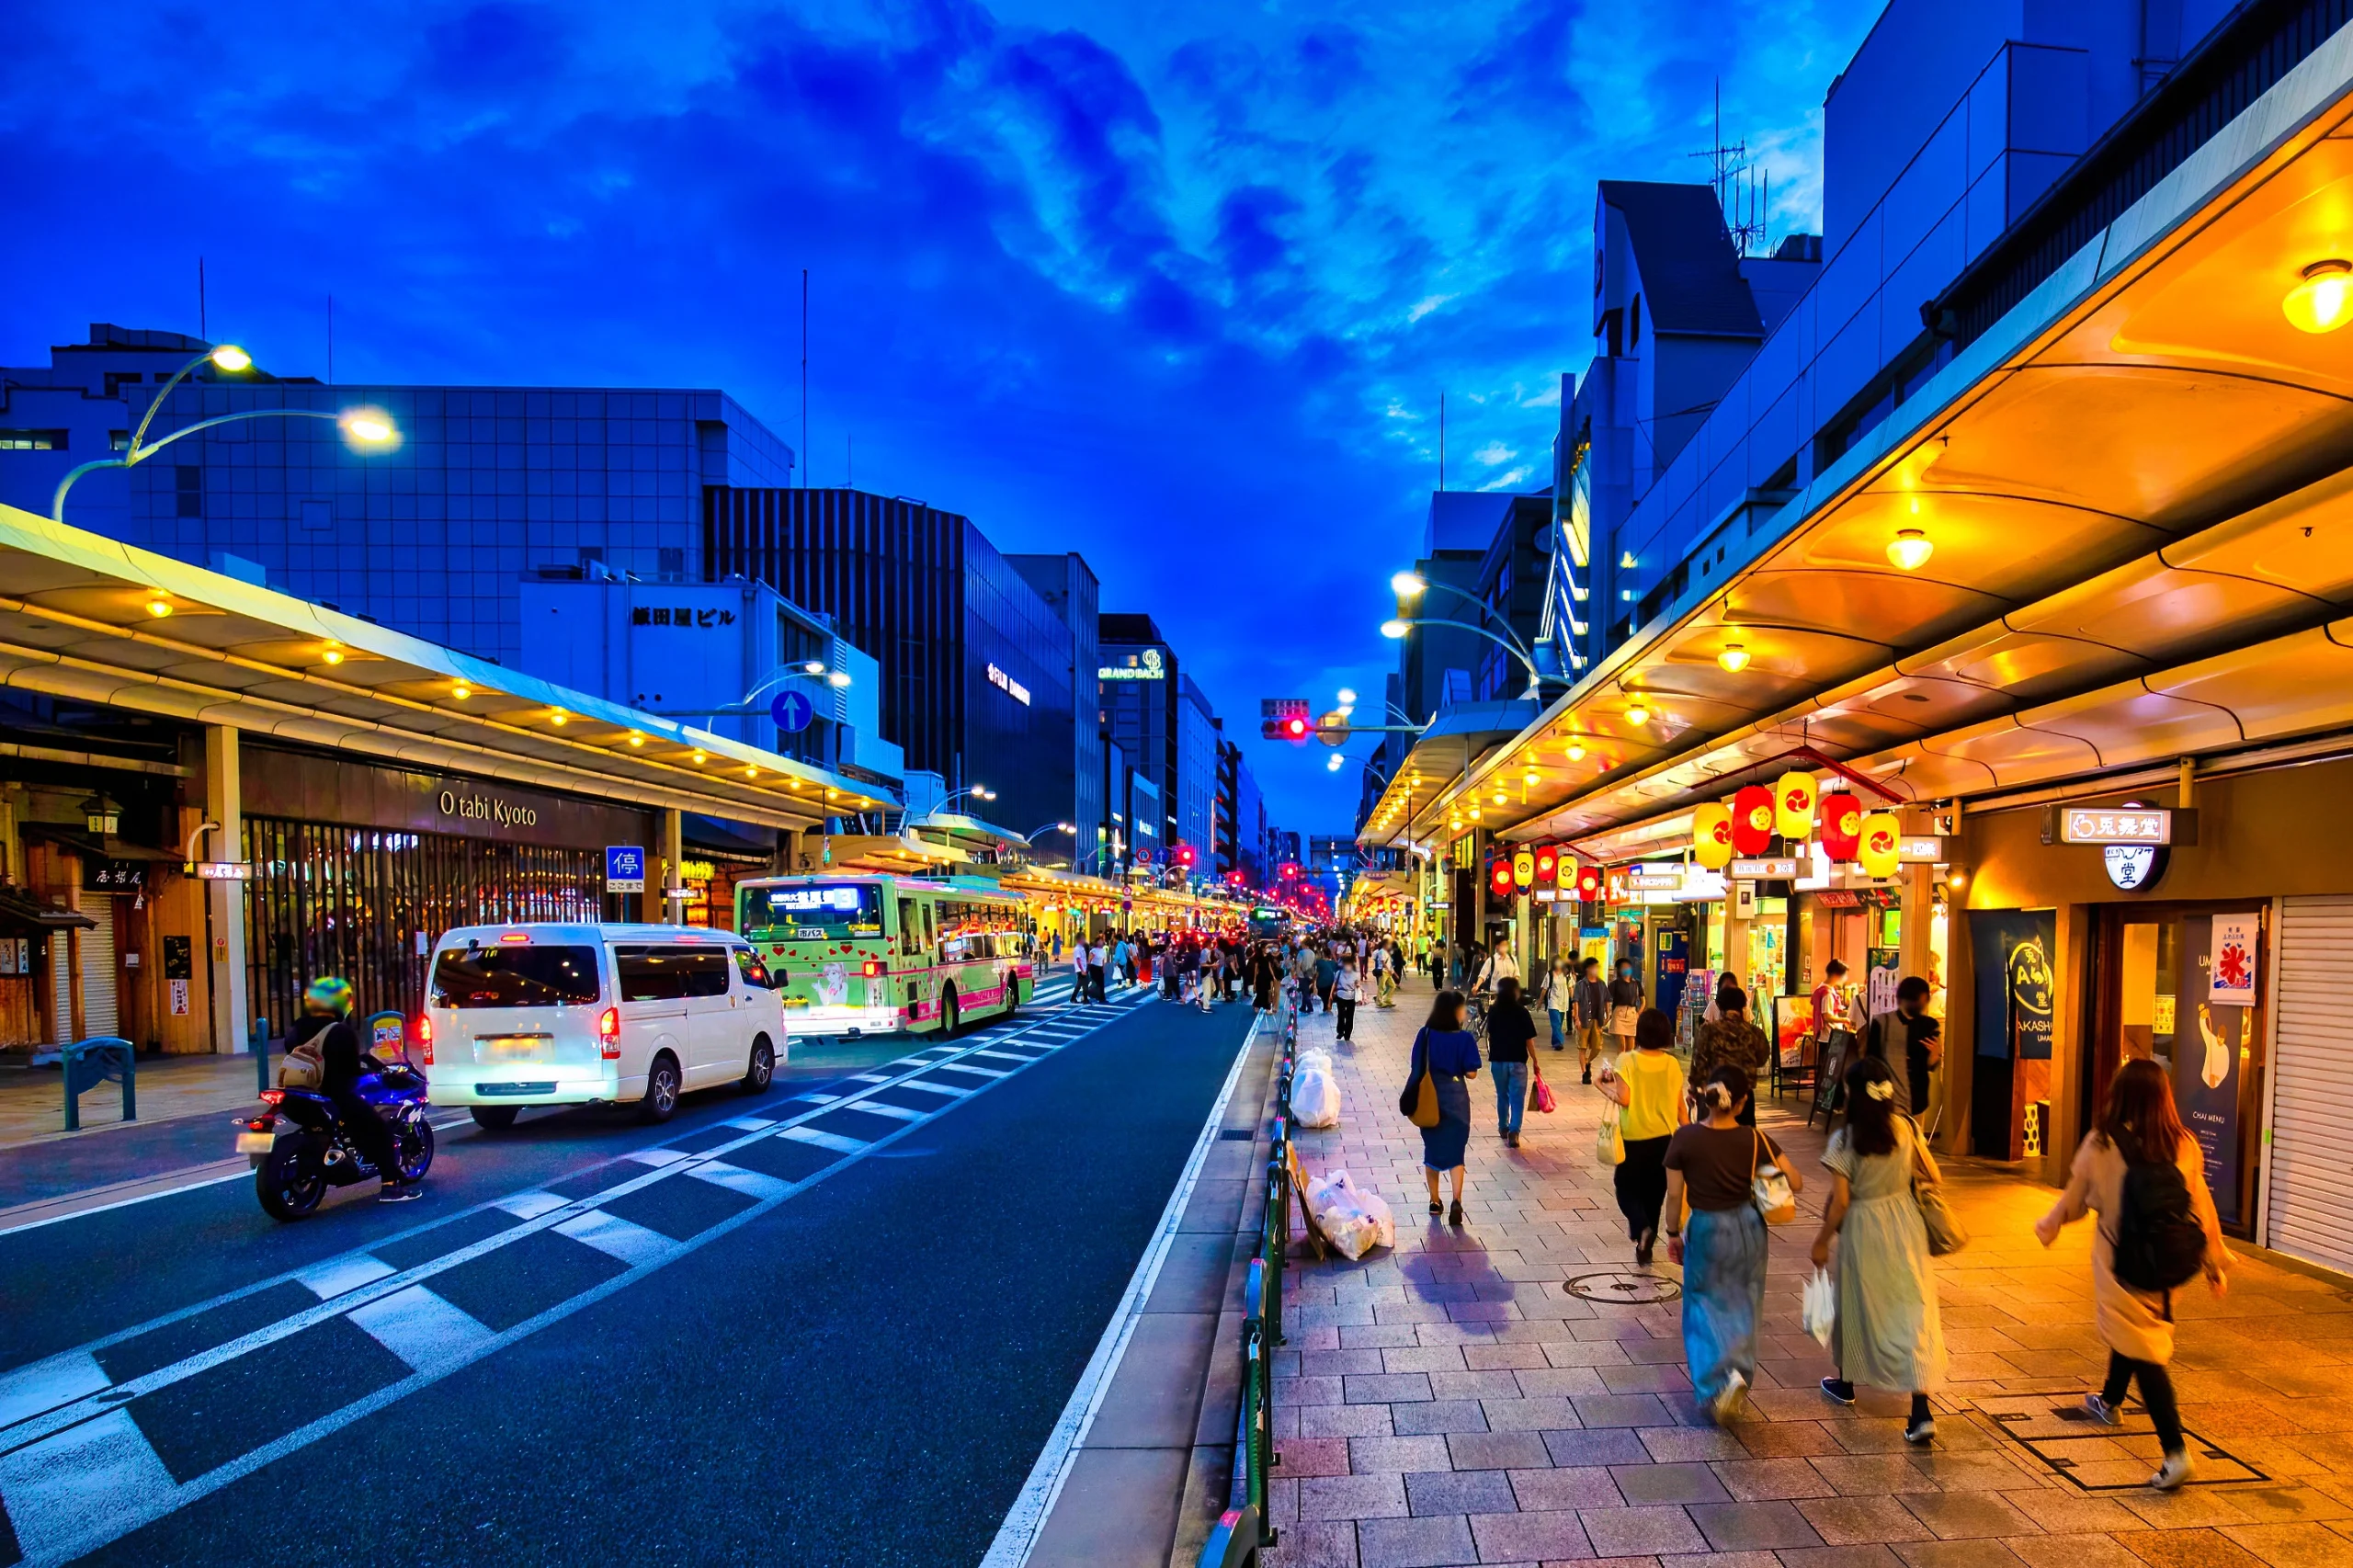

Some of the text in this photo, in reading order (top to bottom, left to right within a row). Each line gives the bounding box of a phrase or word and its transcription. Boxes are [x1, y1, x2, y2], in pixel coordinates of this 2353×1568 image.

[1098, 667, 1164, 679] GRAND BACH
[440, 790, 537, 828] O tabi Kyoto
[613, 853, 638, 874] 停
[799, 929, 823, 938] 市バス
[2199, 955, 2211, 967] UM
[2220, 946, 2245, 984] 氷
